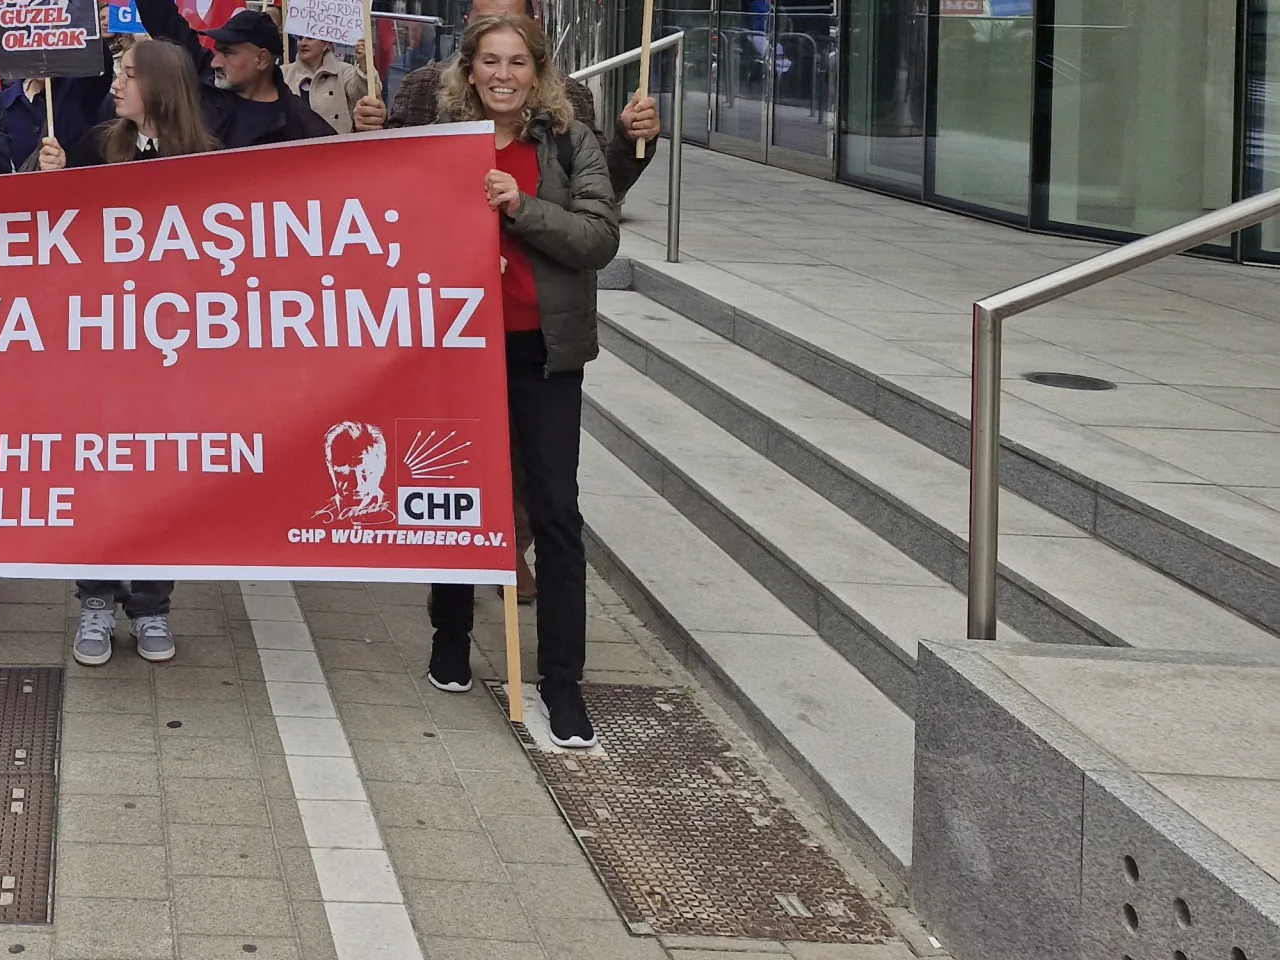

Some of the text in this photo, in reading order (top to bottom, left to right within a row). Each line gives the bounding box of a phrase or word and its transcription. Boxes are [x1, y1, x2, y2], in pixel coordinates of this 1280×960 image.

[0, 5, 69, 25] GÜZEL
[4, 30, 85, 49] OLACAK
[102, 198, 401, 277] BAŞINA;
[67, 272, 486, 367] HİÇBİRİMİZ
[74, 432, 264, 473] RETTEN
[404, 491, 474, 520] CHP
[287, 525, 508, 547] CHP WÜRTTEMBERG e.V.
